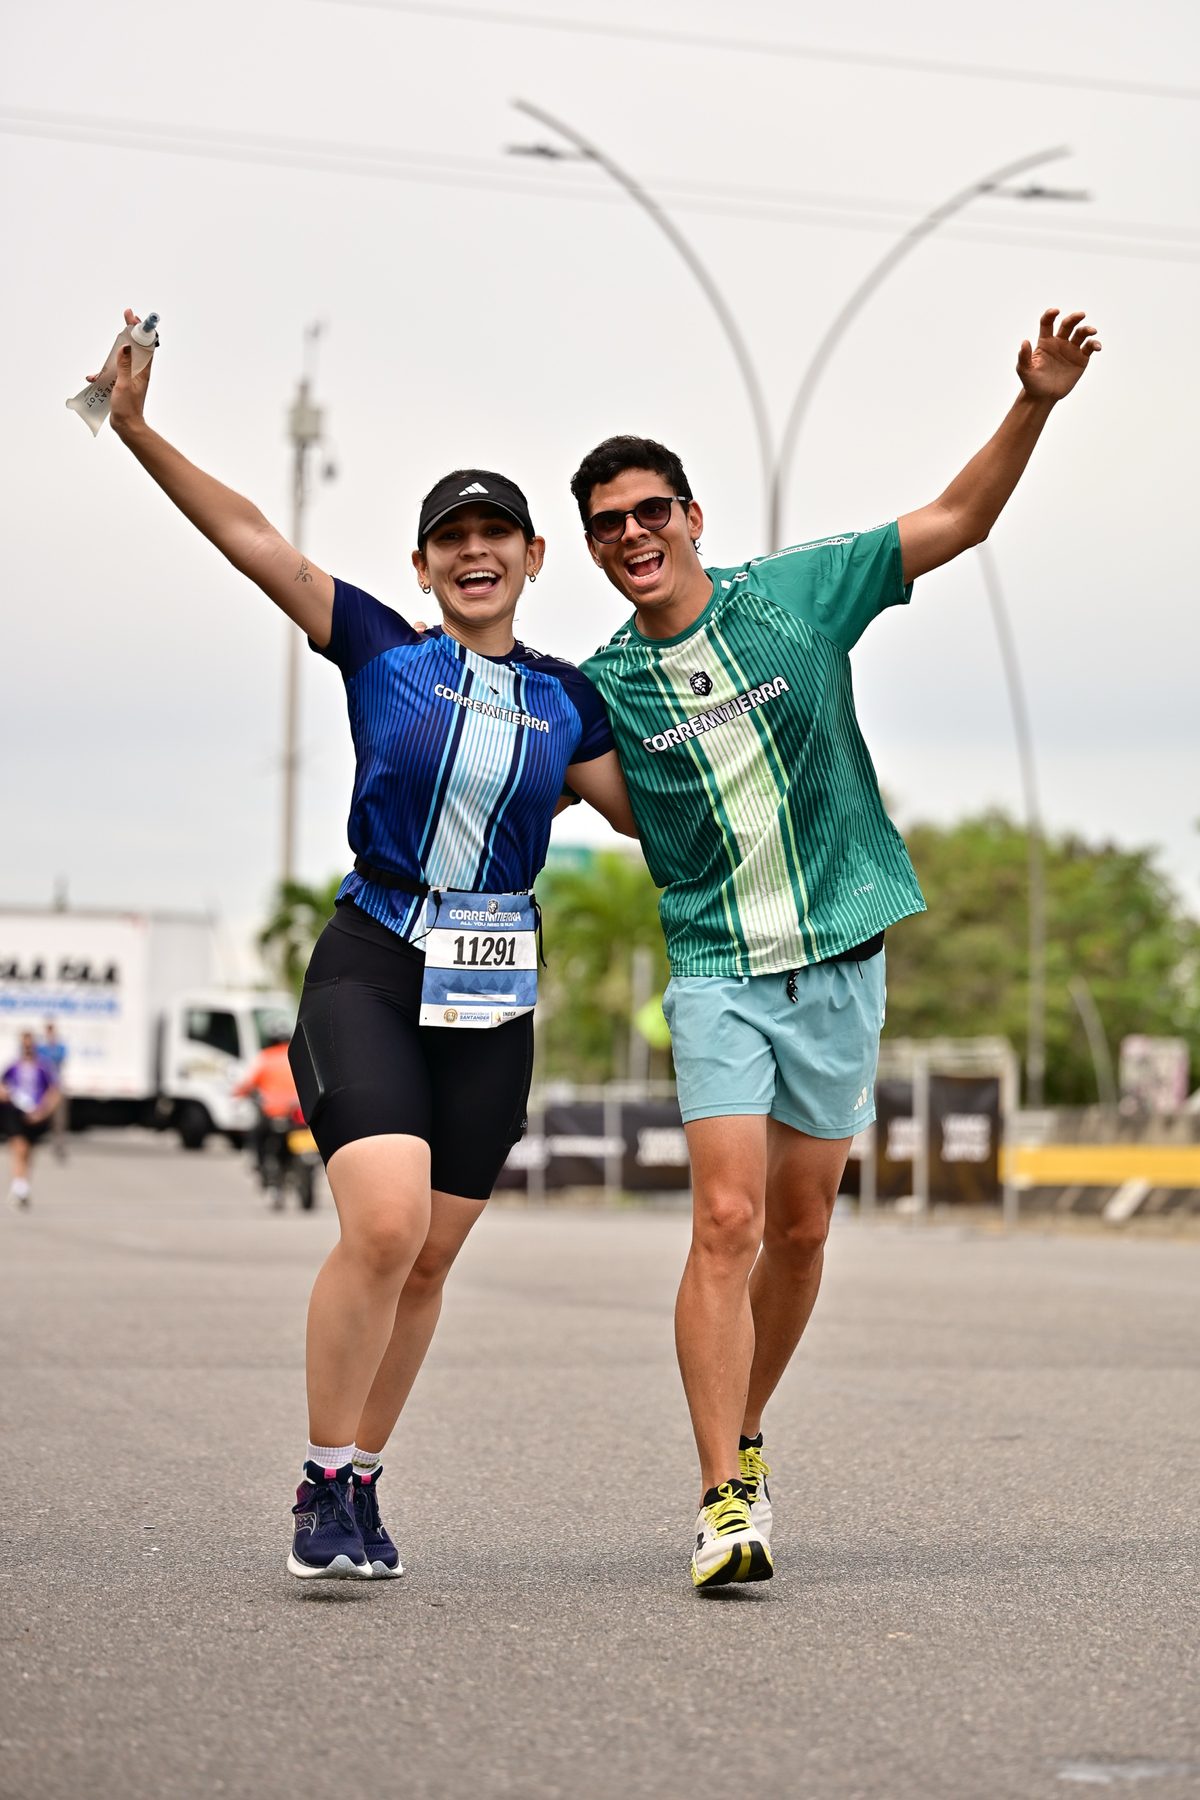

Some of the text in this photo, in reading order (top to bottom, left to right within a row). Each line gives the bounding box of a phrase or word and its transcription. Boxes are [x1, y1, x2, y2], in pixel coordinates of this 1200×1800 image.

[87, 387, 103, 408] SPOT
[99, 379, 117, 403] WEAT
[453, 936, 516, 966] 11291
